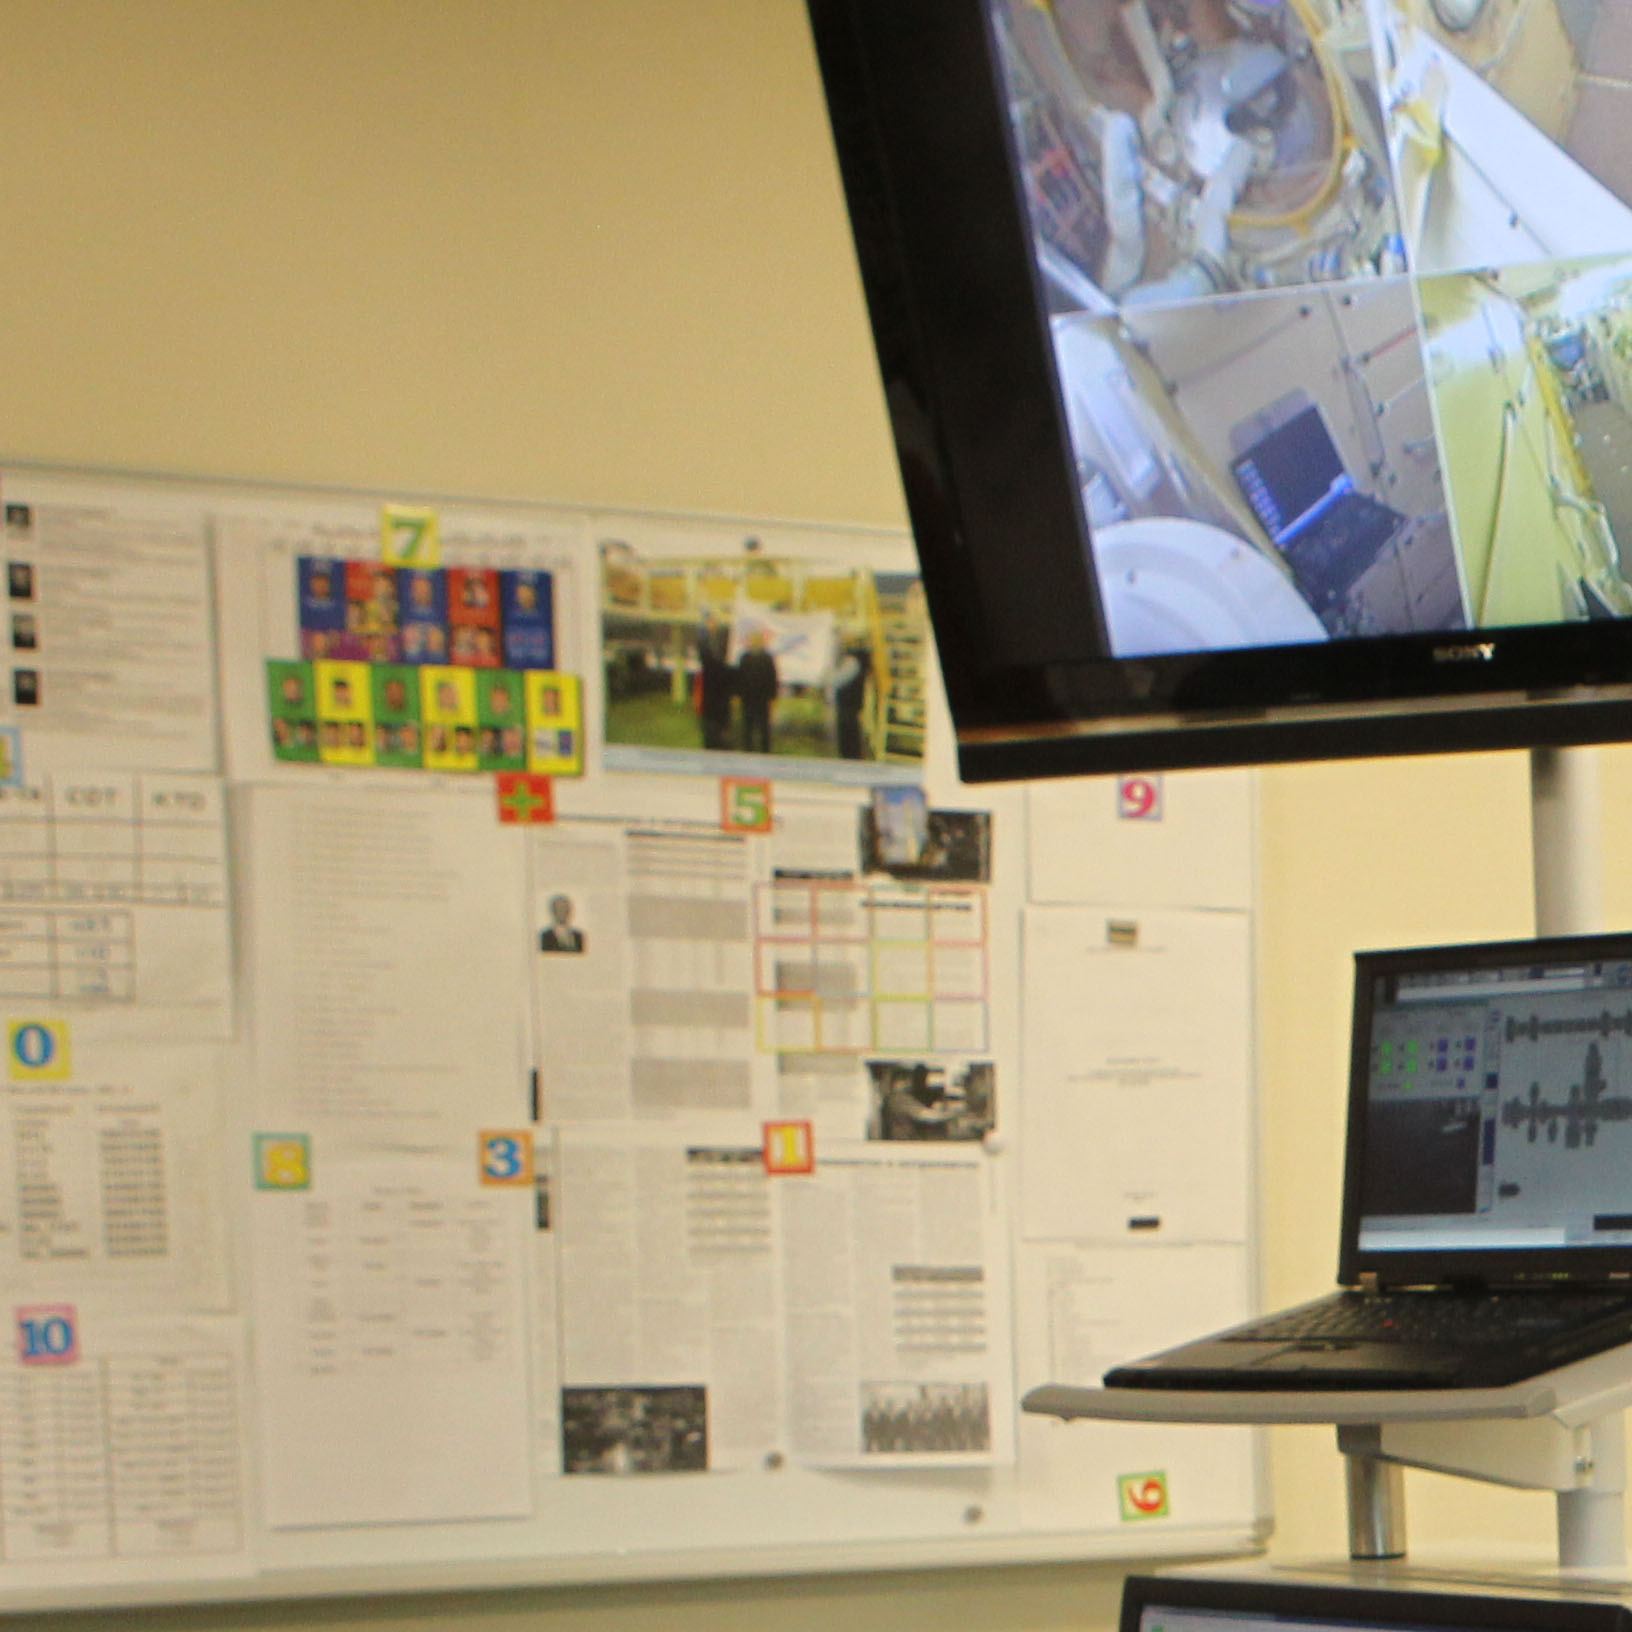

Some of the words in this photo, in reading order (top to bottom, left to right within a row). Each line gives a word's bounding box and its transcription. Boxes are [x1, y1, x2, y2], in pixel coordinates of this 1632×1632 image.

[393, 522, 428, 558] 7
[733, 786, 769, 826] 5
[1121, 781, 1155, 817] 9
[486, 1139, 522, 1179] 3
[772, 1129, 804, 1165] 1
[21, 1318, 73, 1357] 10
